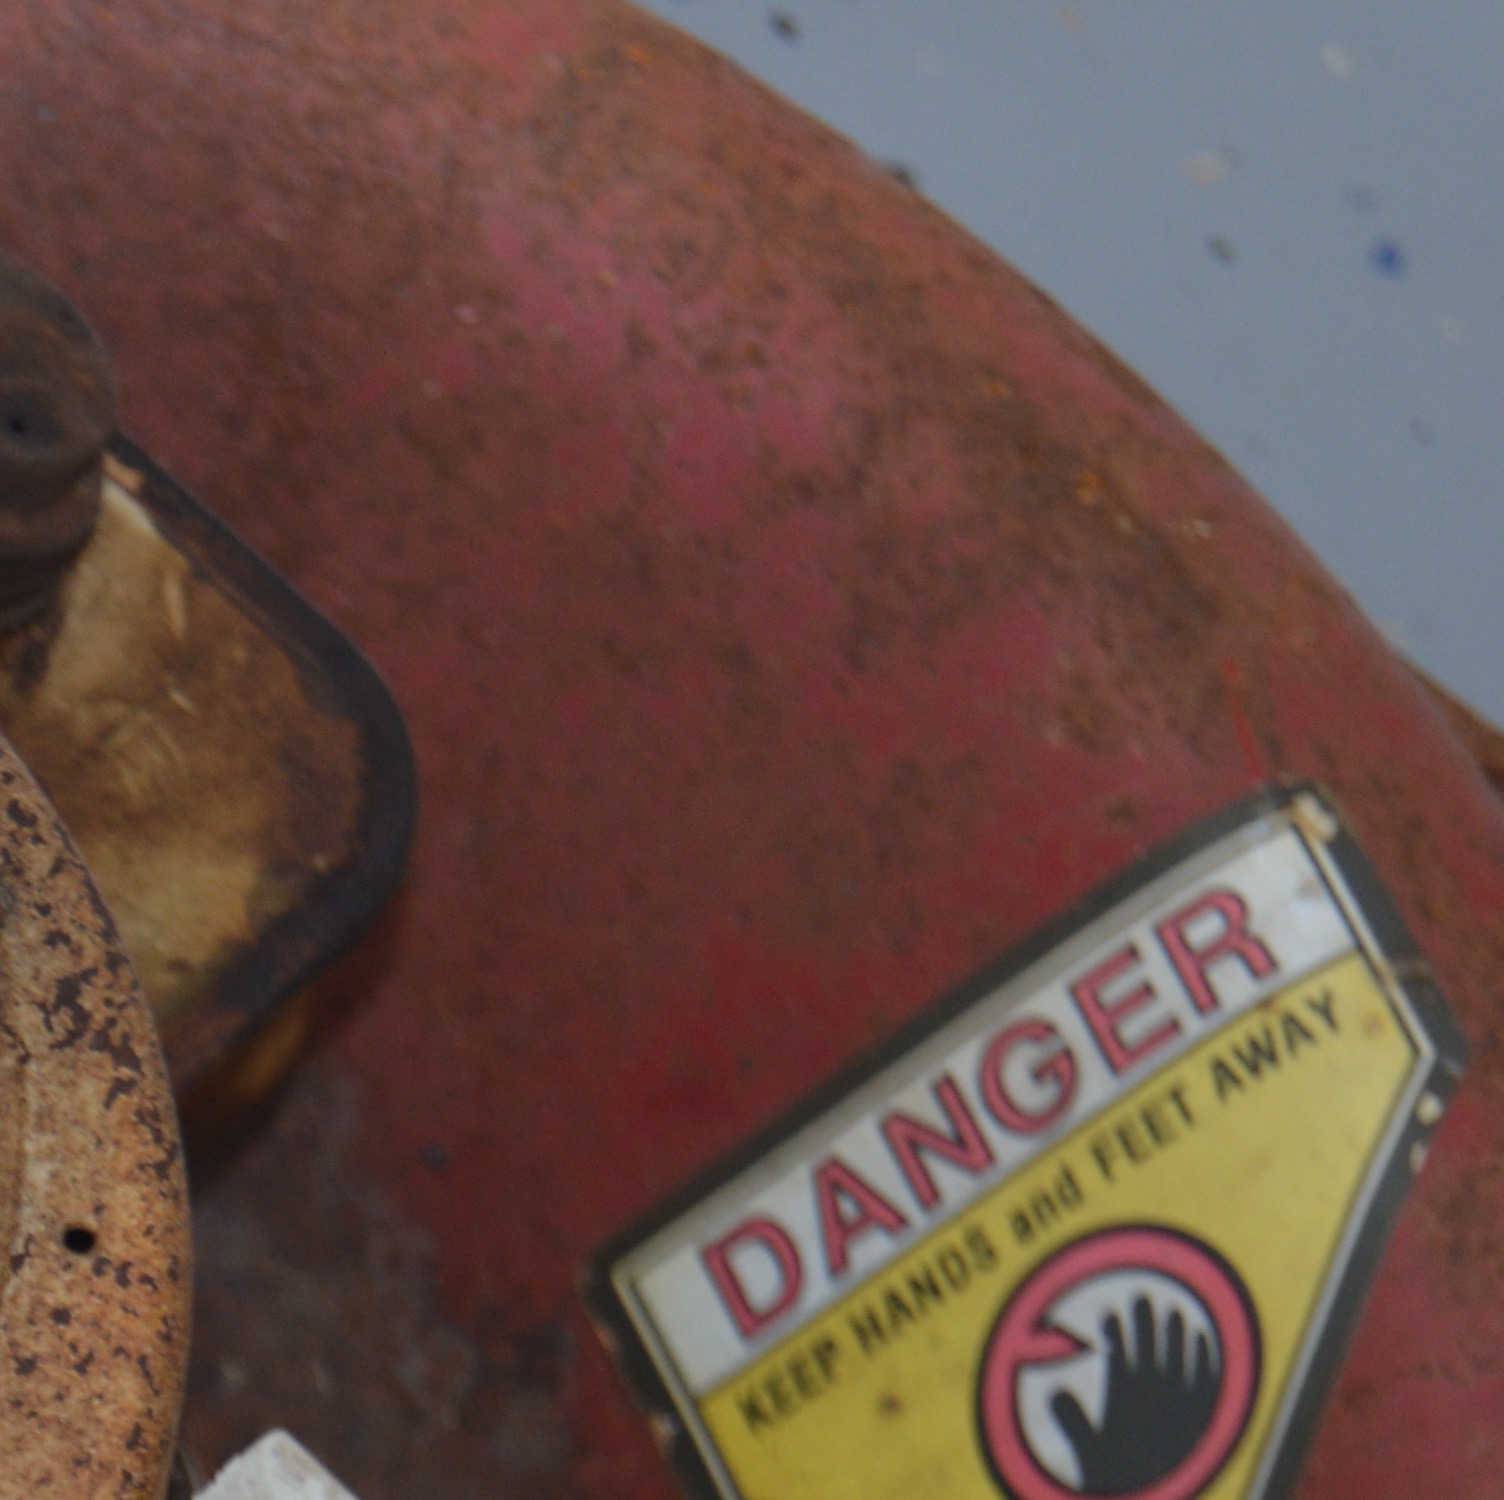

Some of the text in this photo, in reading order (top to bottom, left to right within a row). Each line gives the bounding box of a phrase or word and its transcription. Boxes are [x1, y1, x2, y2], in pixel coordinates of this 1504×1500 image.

[699, 887, 1280, 1341] DANGER
[733, 989, 1344, 1437] KEEP HANDS and FEET AWAY
